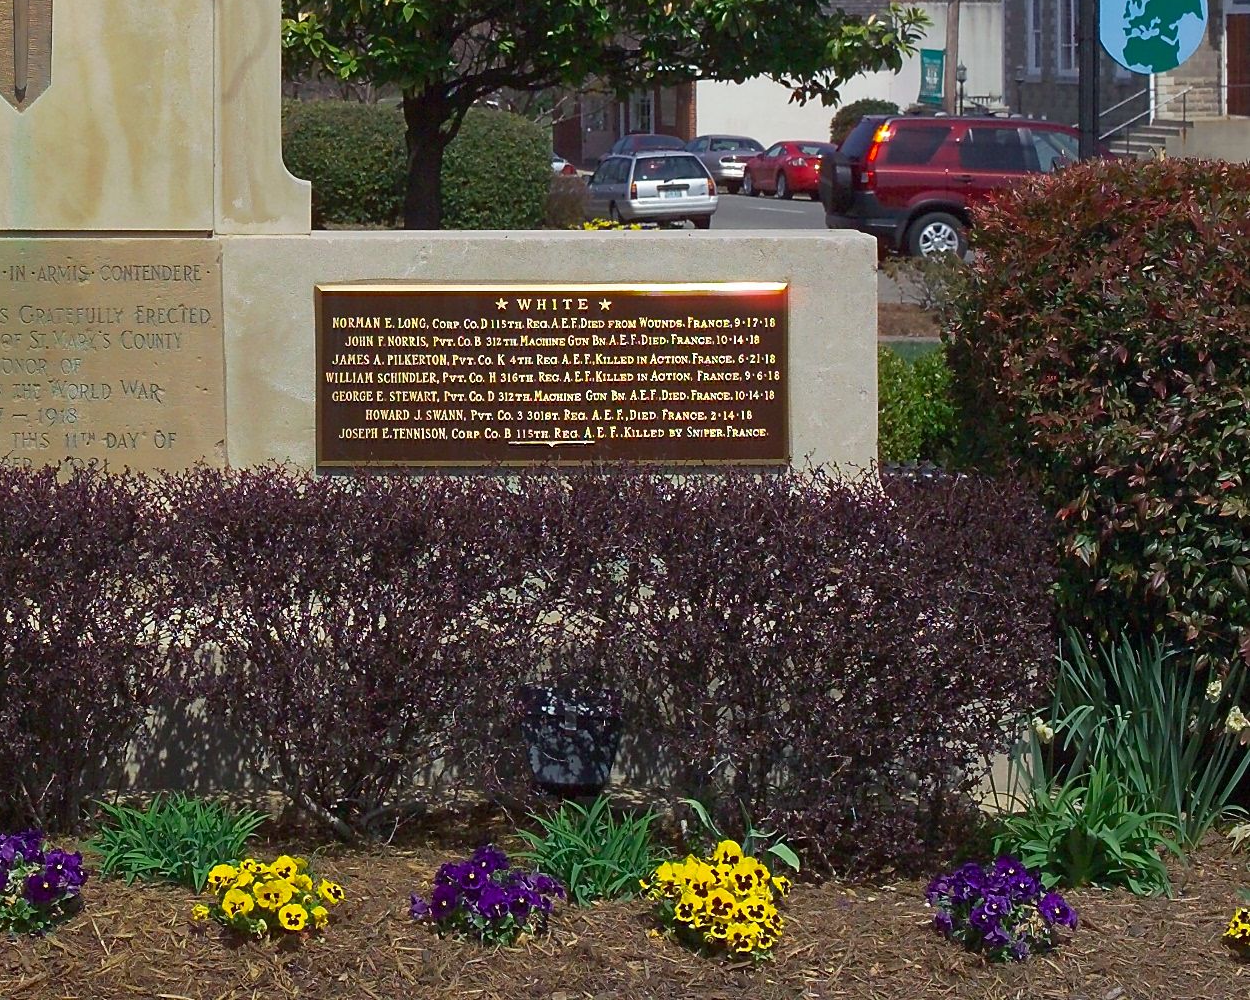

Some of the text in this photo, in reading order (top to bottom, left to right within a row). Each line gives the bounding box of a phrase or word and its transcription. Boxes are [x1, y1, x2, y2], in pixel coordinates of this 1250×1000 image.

[10, 266, 26, 282] IN
[100, 266, 202, 284] CONTENDERE
[517, 298, 589, 310] WHITE
[136, 306, 211, 324] ERECTED
[332, 318, 380, 329] NORMAN
[480, 318, 488, 329] D
[580, 317, 604, 328] DIED
[607, 320, 636, 328] FROM
[1, 334, 22, 350] OF
[121, 331, 182, 350] COUNTY
[345, 336, 374, 347] JOHN
[474, 335, 482, 346] B
[519, 335, 566, 346] MACHINE
[567, 335, 590, 346] GUN
[332, 355, 370, 366] JAMES
[497, 354, 505, 365] K
[595, 354, 634, 364] KILLED
[637, 356, 647, 364] IN
[61, 358, 81, 375] OF
[325, 372, 373, 384] WILLIAM
[489, 371, 496, 383] H
[595, 371, 634, 382] KILLED
[637, 373, 648, 382] IN
[332, 391, 373, 402] GEORGE
[487, 390, 495, 401] D
[534, 390, 581, 401] MACHINE
[585, 390, 608, 401] GUN
[38, 408, 78, 426] 1918
[366, 409, 410, 420] HOWARD
[339, 428, 378, 439] JOSEPH
[504, 427, 511, 438] B
[623, 427, 665, 438] KILLED
[669, 429, 682, 438] BY
[12, 433, 49, 449] THIS
[106, 433, 138, 449] DAY
[154, 432, 177, 448] OF
